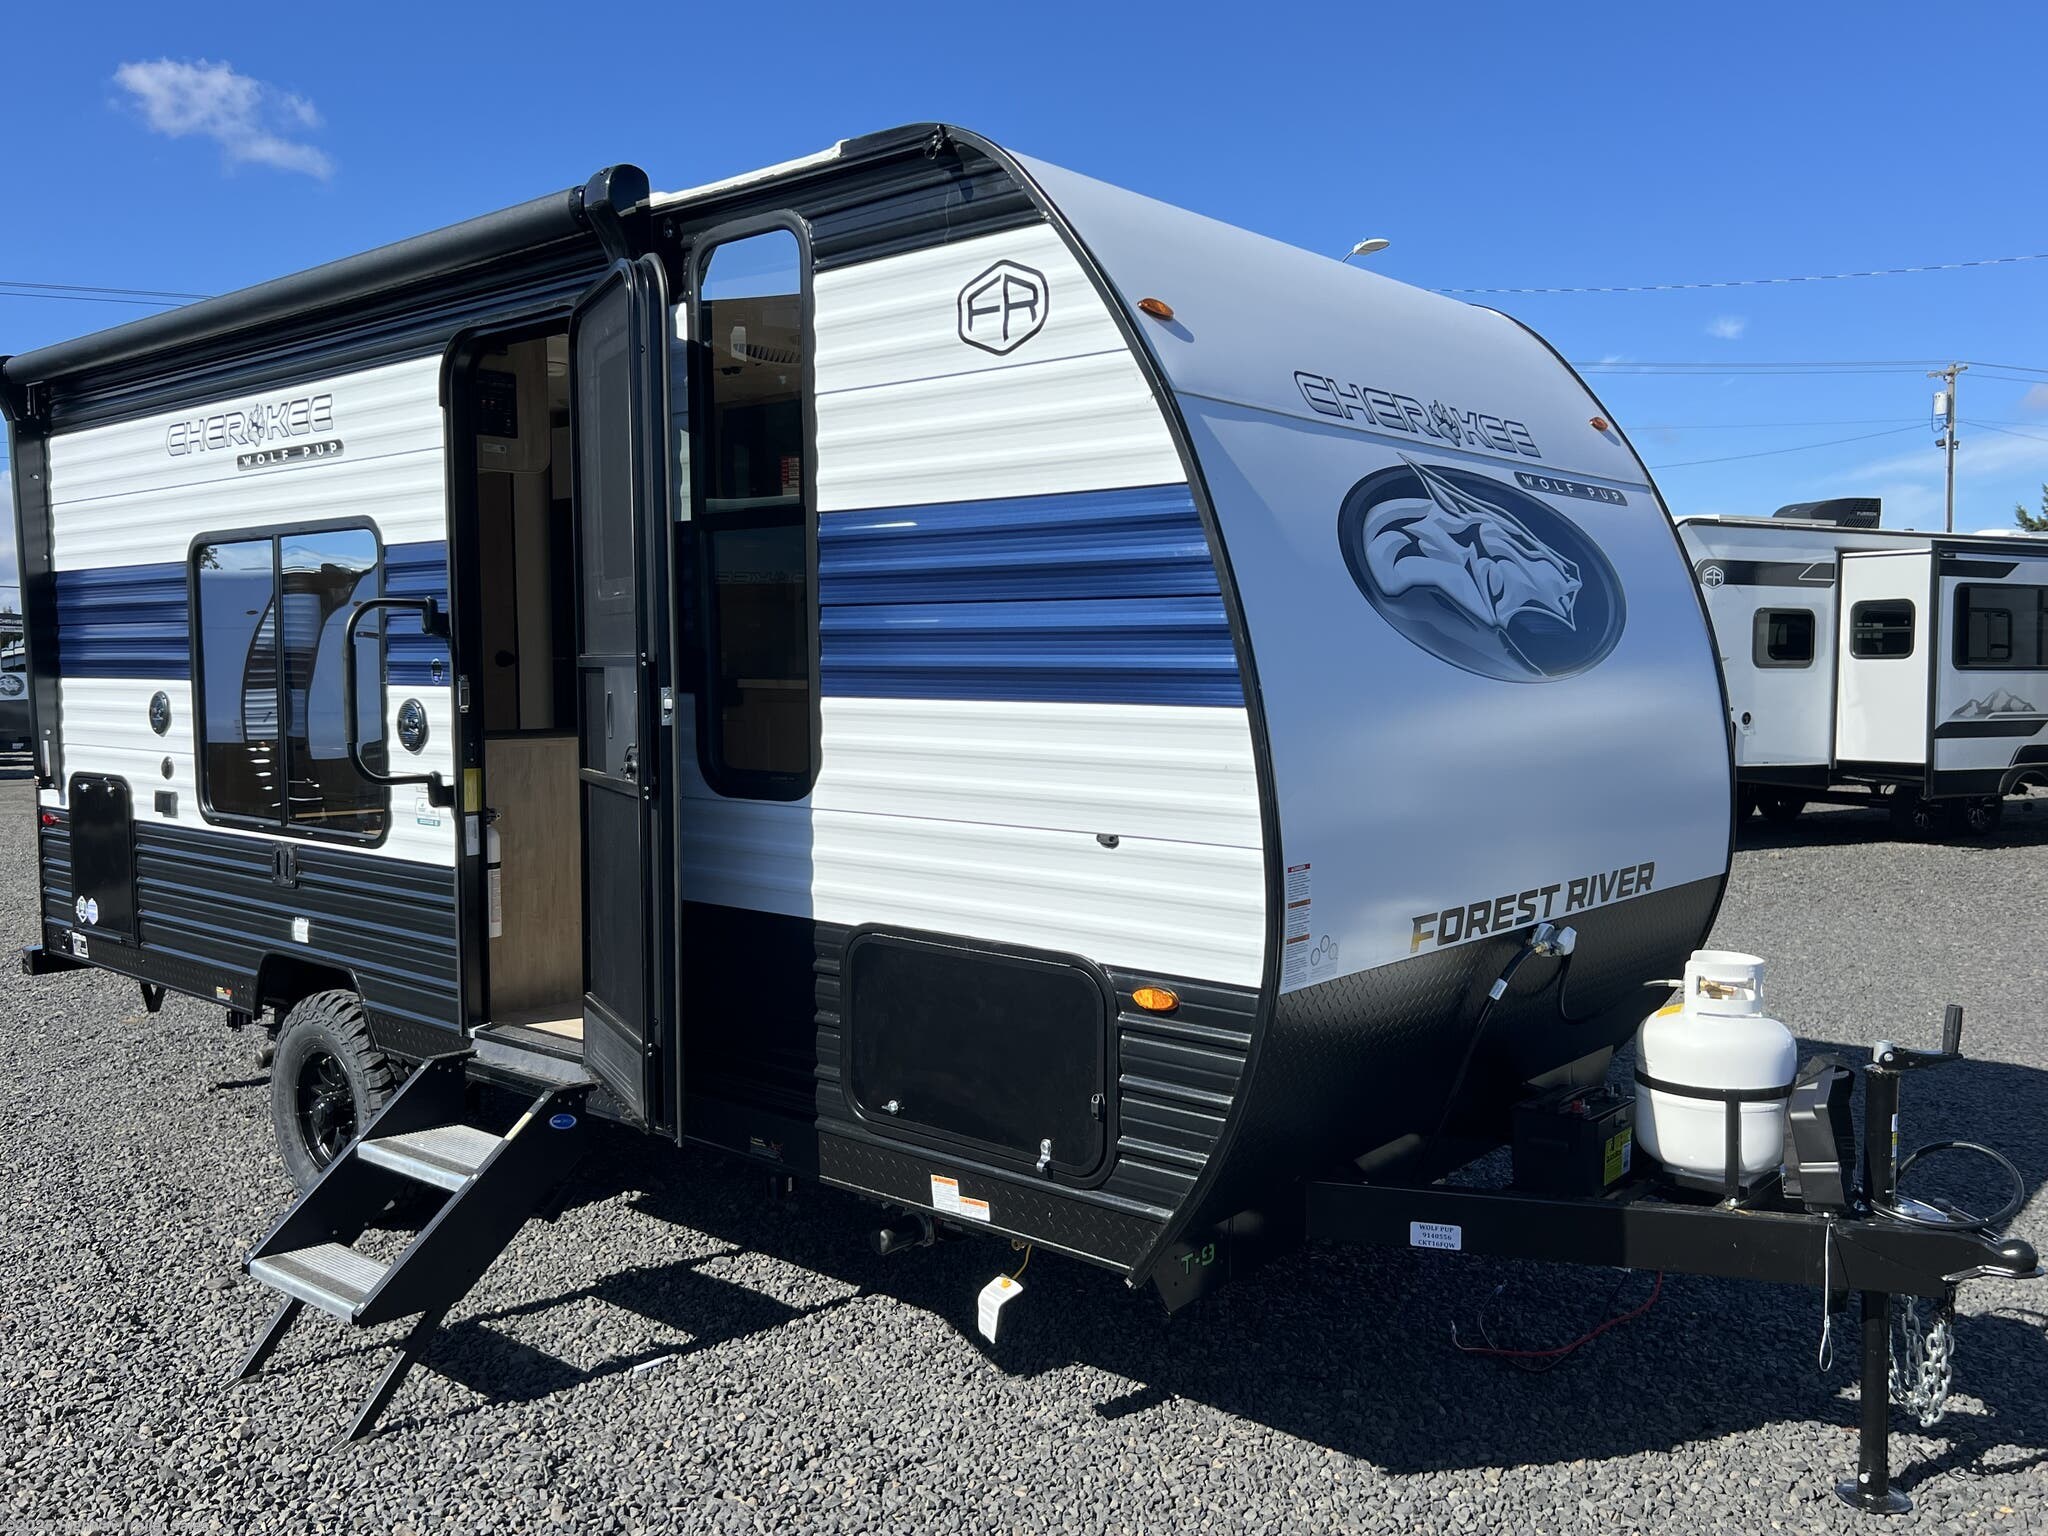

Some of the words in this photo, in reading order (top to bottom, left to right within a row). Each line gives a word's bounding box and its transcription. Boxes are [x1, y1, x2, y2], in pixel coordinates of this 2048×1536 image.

[242, 449, 289, 466] WOLF
[303, 442, 338, 458] PUP
[1521, 474, 1575, 494] WOLF
[1586, 486, 1622, 503] PUP
[1410, 883, 1561, 953] FOREST
[1566, 861, 1656, 912] RIVER
